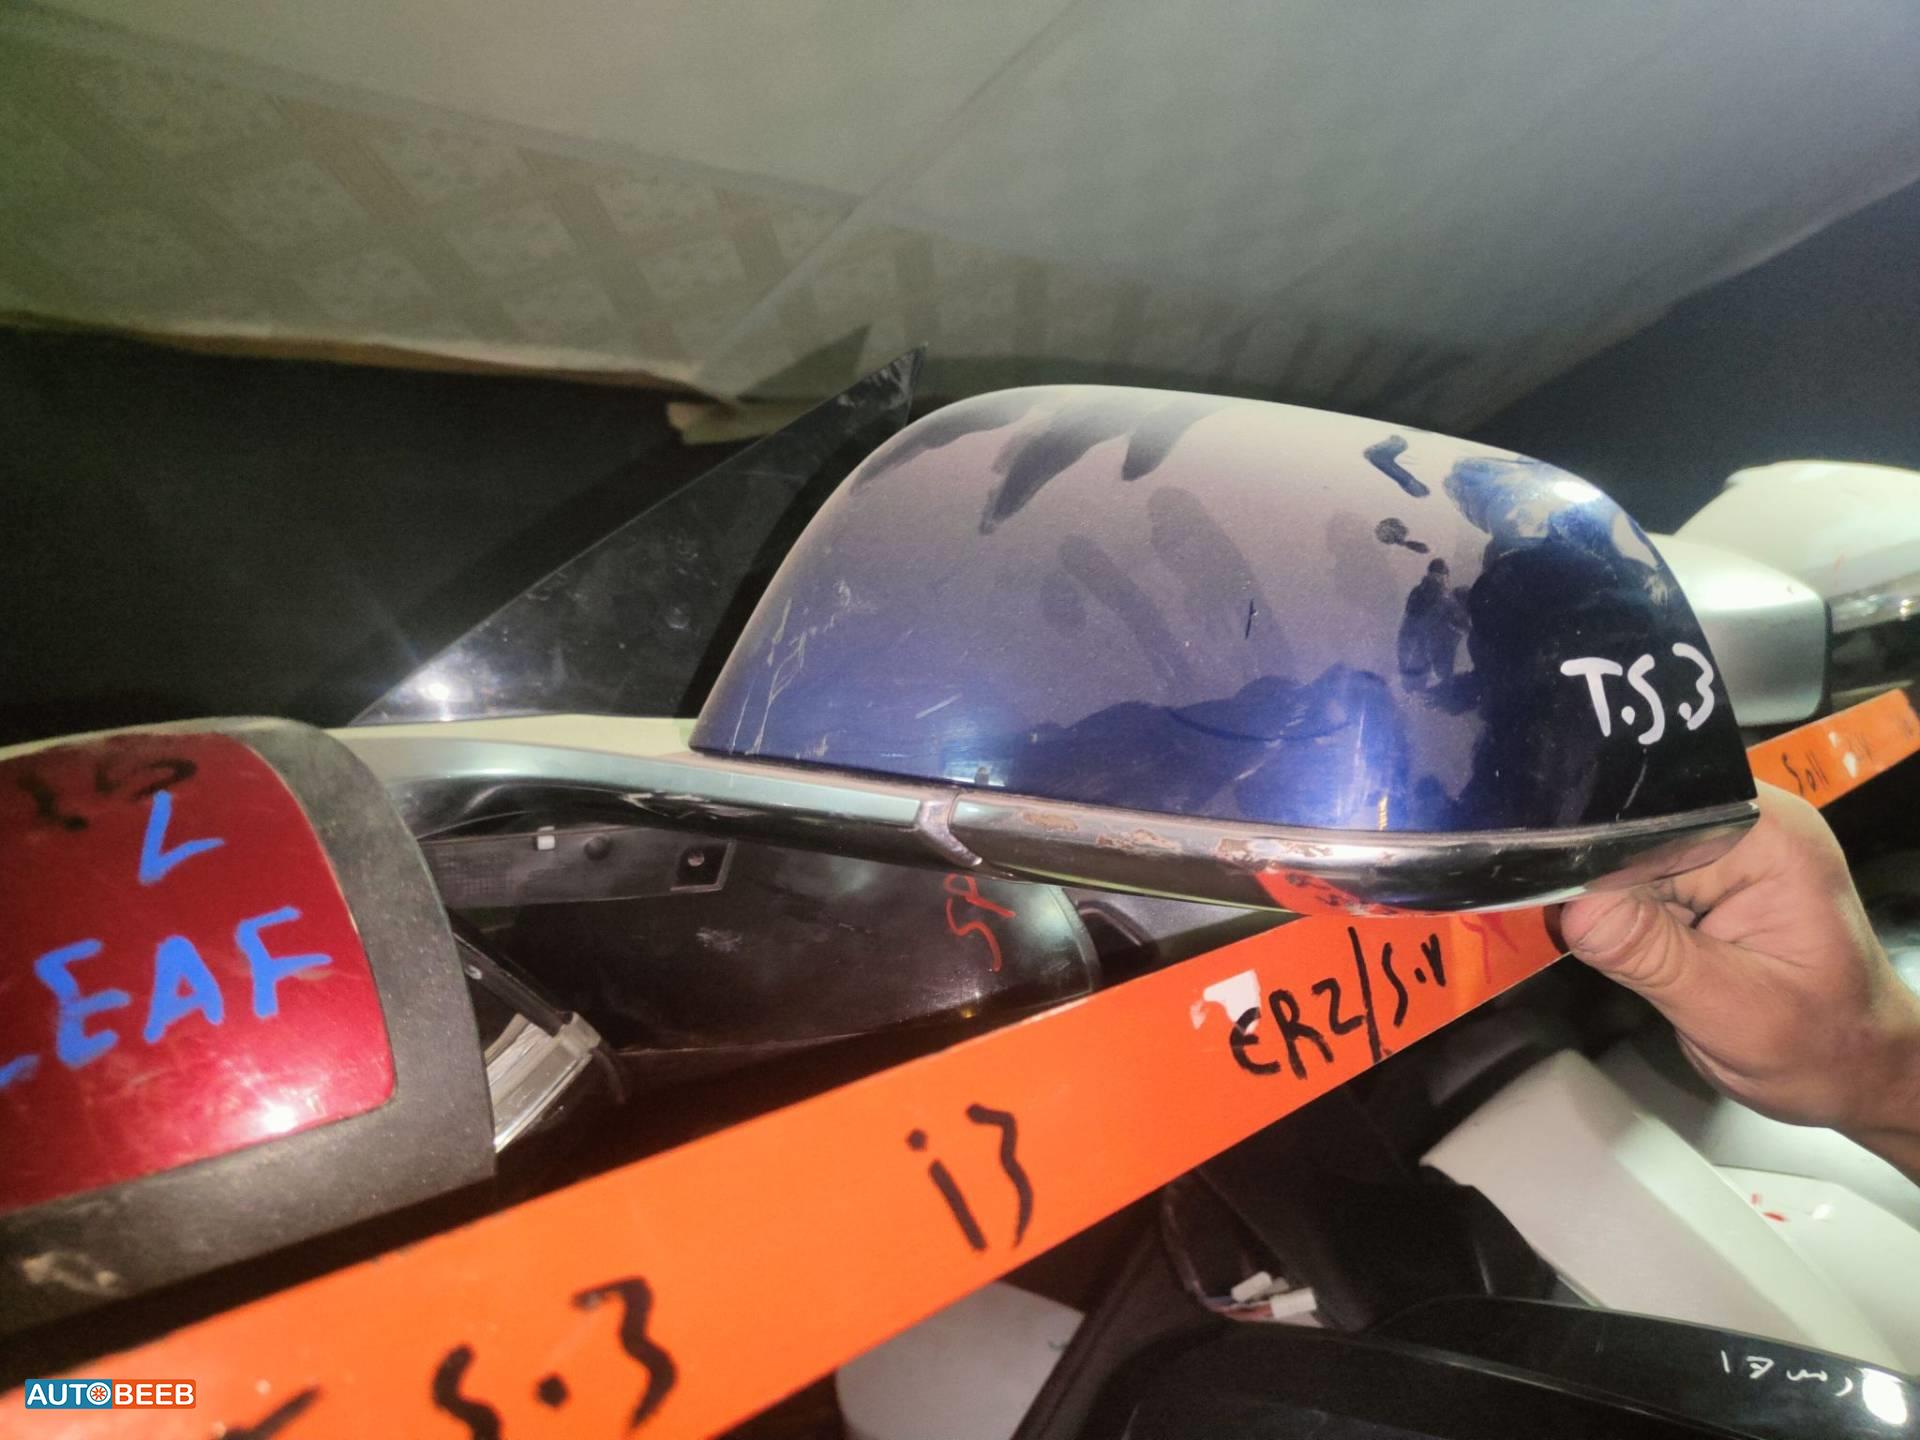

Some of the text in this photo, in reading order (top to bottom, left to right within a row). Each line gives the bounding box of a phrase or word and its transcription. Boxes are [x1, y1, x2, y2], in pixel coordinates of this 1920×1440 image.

[1559, 642, 1714, 745] T.S.3
[139, 790, 225, 886] L
[906, 1103, 1034, 1252] i3
